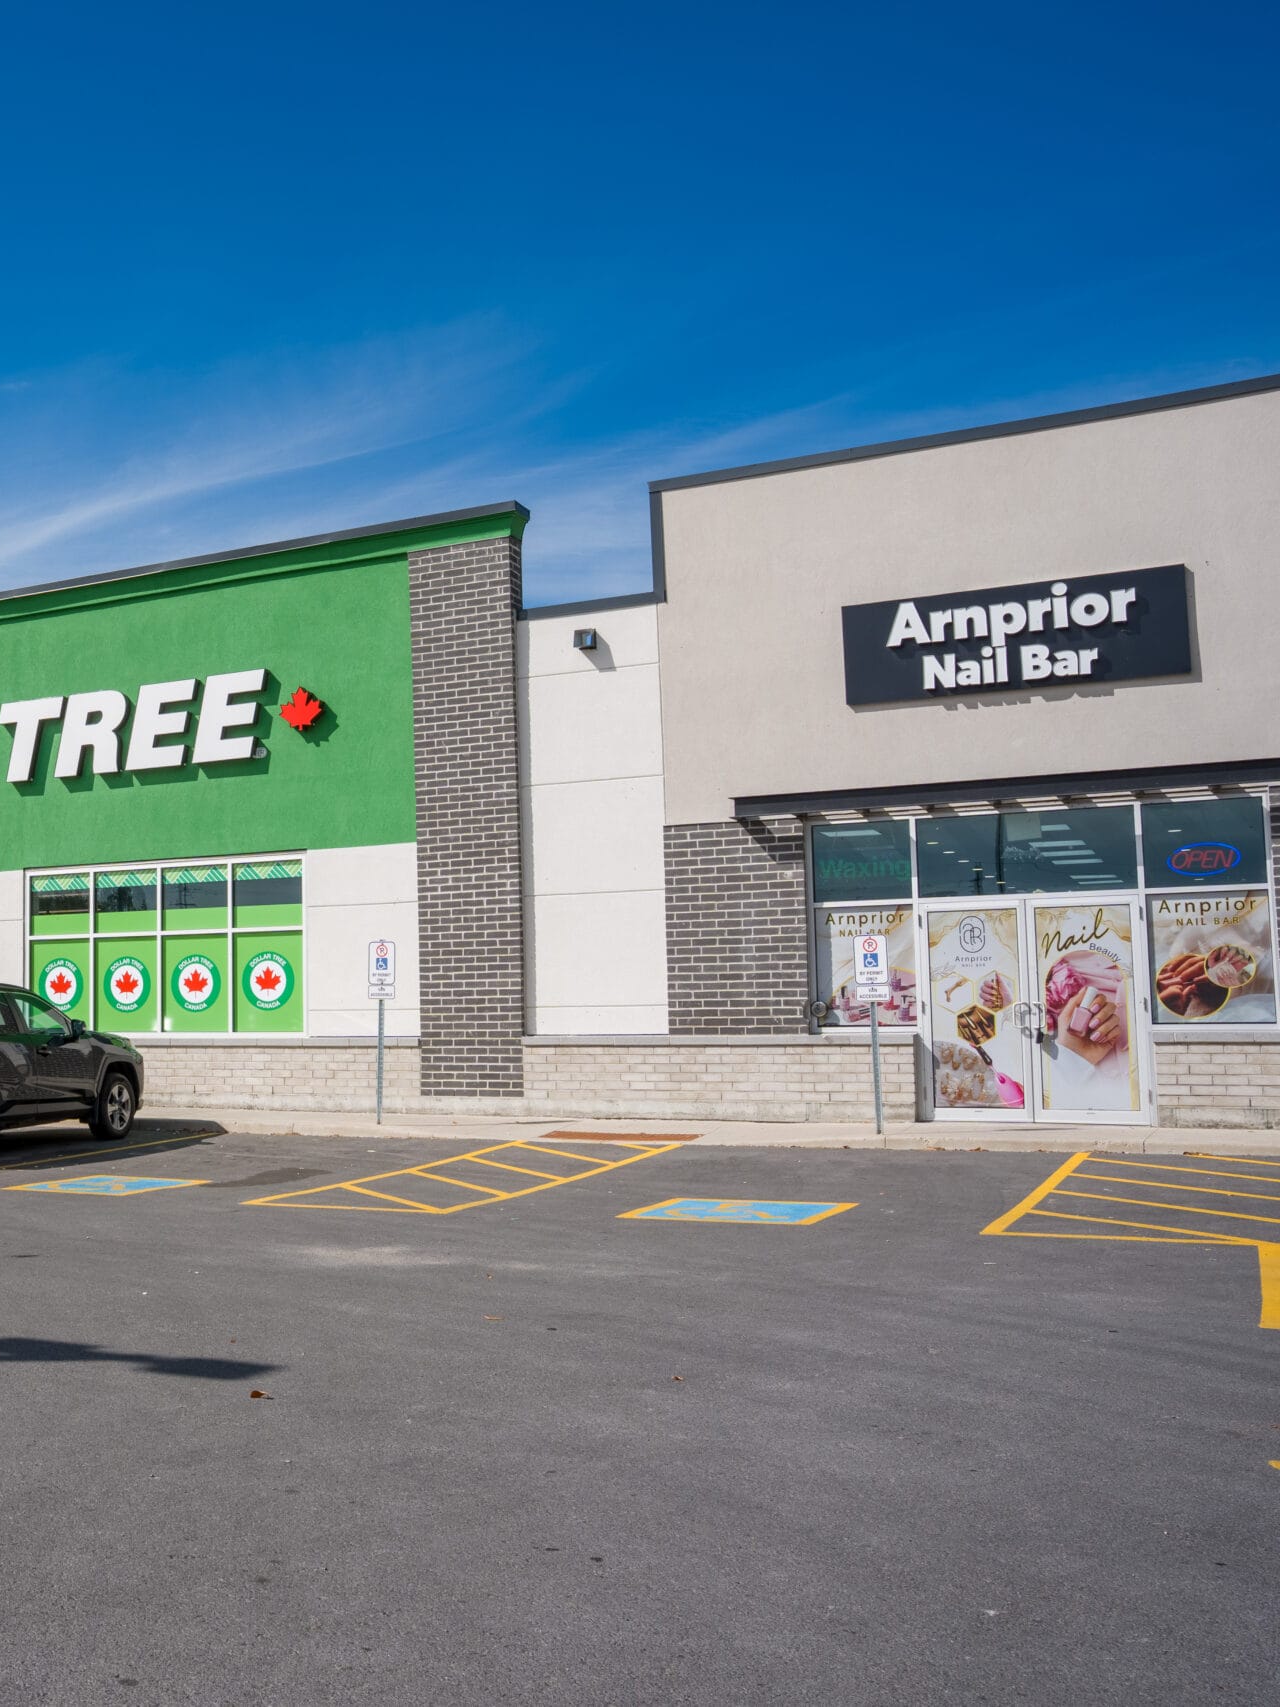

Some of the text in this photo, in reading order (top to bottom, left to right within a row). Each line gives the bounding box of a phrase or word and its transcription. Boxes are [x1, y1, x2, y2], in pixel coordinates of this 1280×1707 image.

[885, 581, 1137, 647] Arnprior
[923, 644, 1099, 690] Nail Bar
[1171, 849, 1235, 870] OPEN
[818, 856, 911, 881] Waxing
[1159, 897, 1256, 915] Arnprior
[825, 911, 904, 927] Arnprior
[1176, 916, 1240, 926] NAIL BAR
[1041, 908, 1110, 959] Nail
[954, 955, 992, 963] Arnprior
[1089, 942, 1123, 963] Beauty
[45, 960, 77, 973] DOLLAR TREE
[110, 958, 144, 971] DOLLAR TREE
[178, 956, 214, 970] DOLLAR TREE
[249, 953, 287, 968] DOLLAR TREE
[184, 1002, 207, 1010] CANADA
[256, 1000, 281, 1008] CANADA
